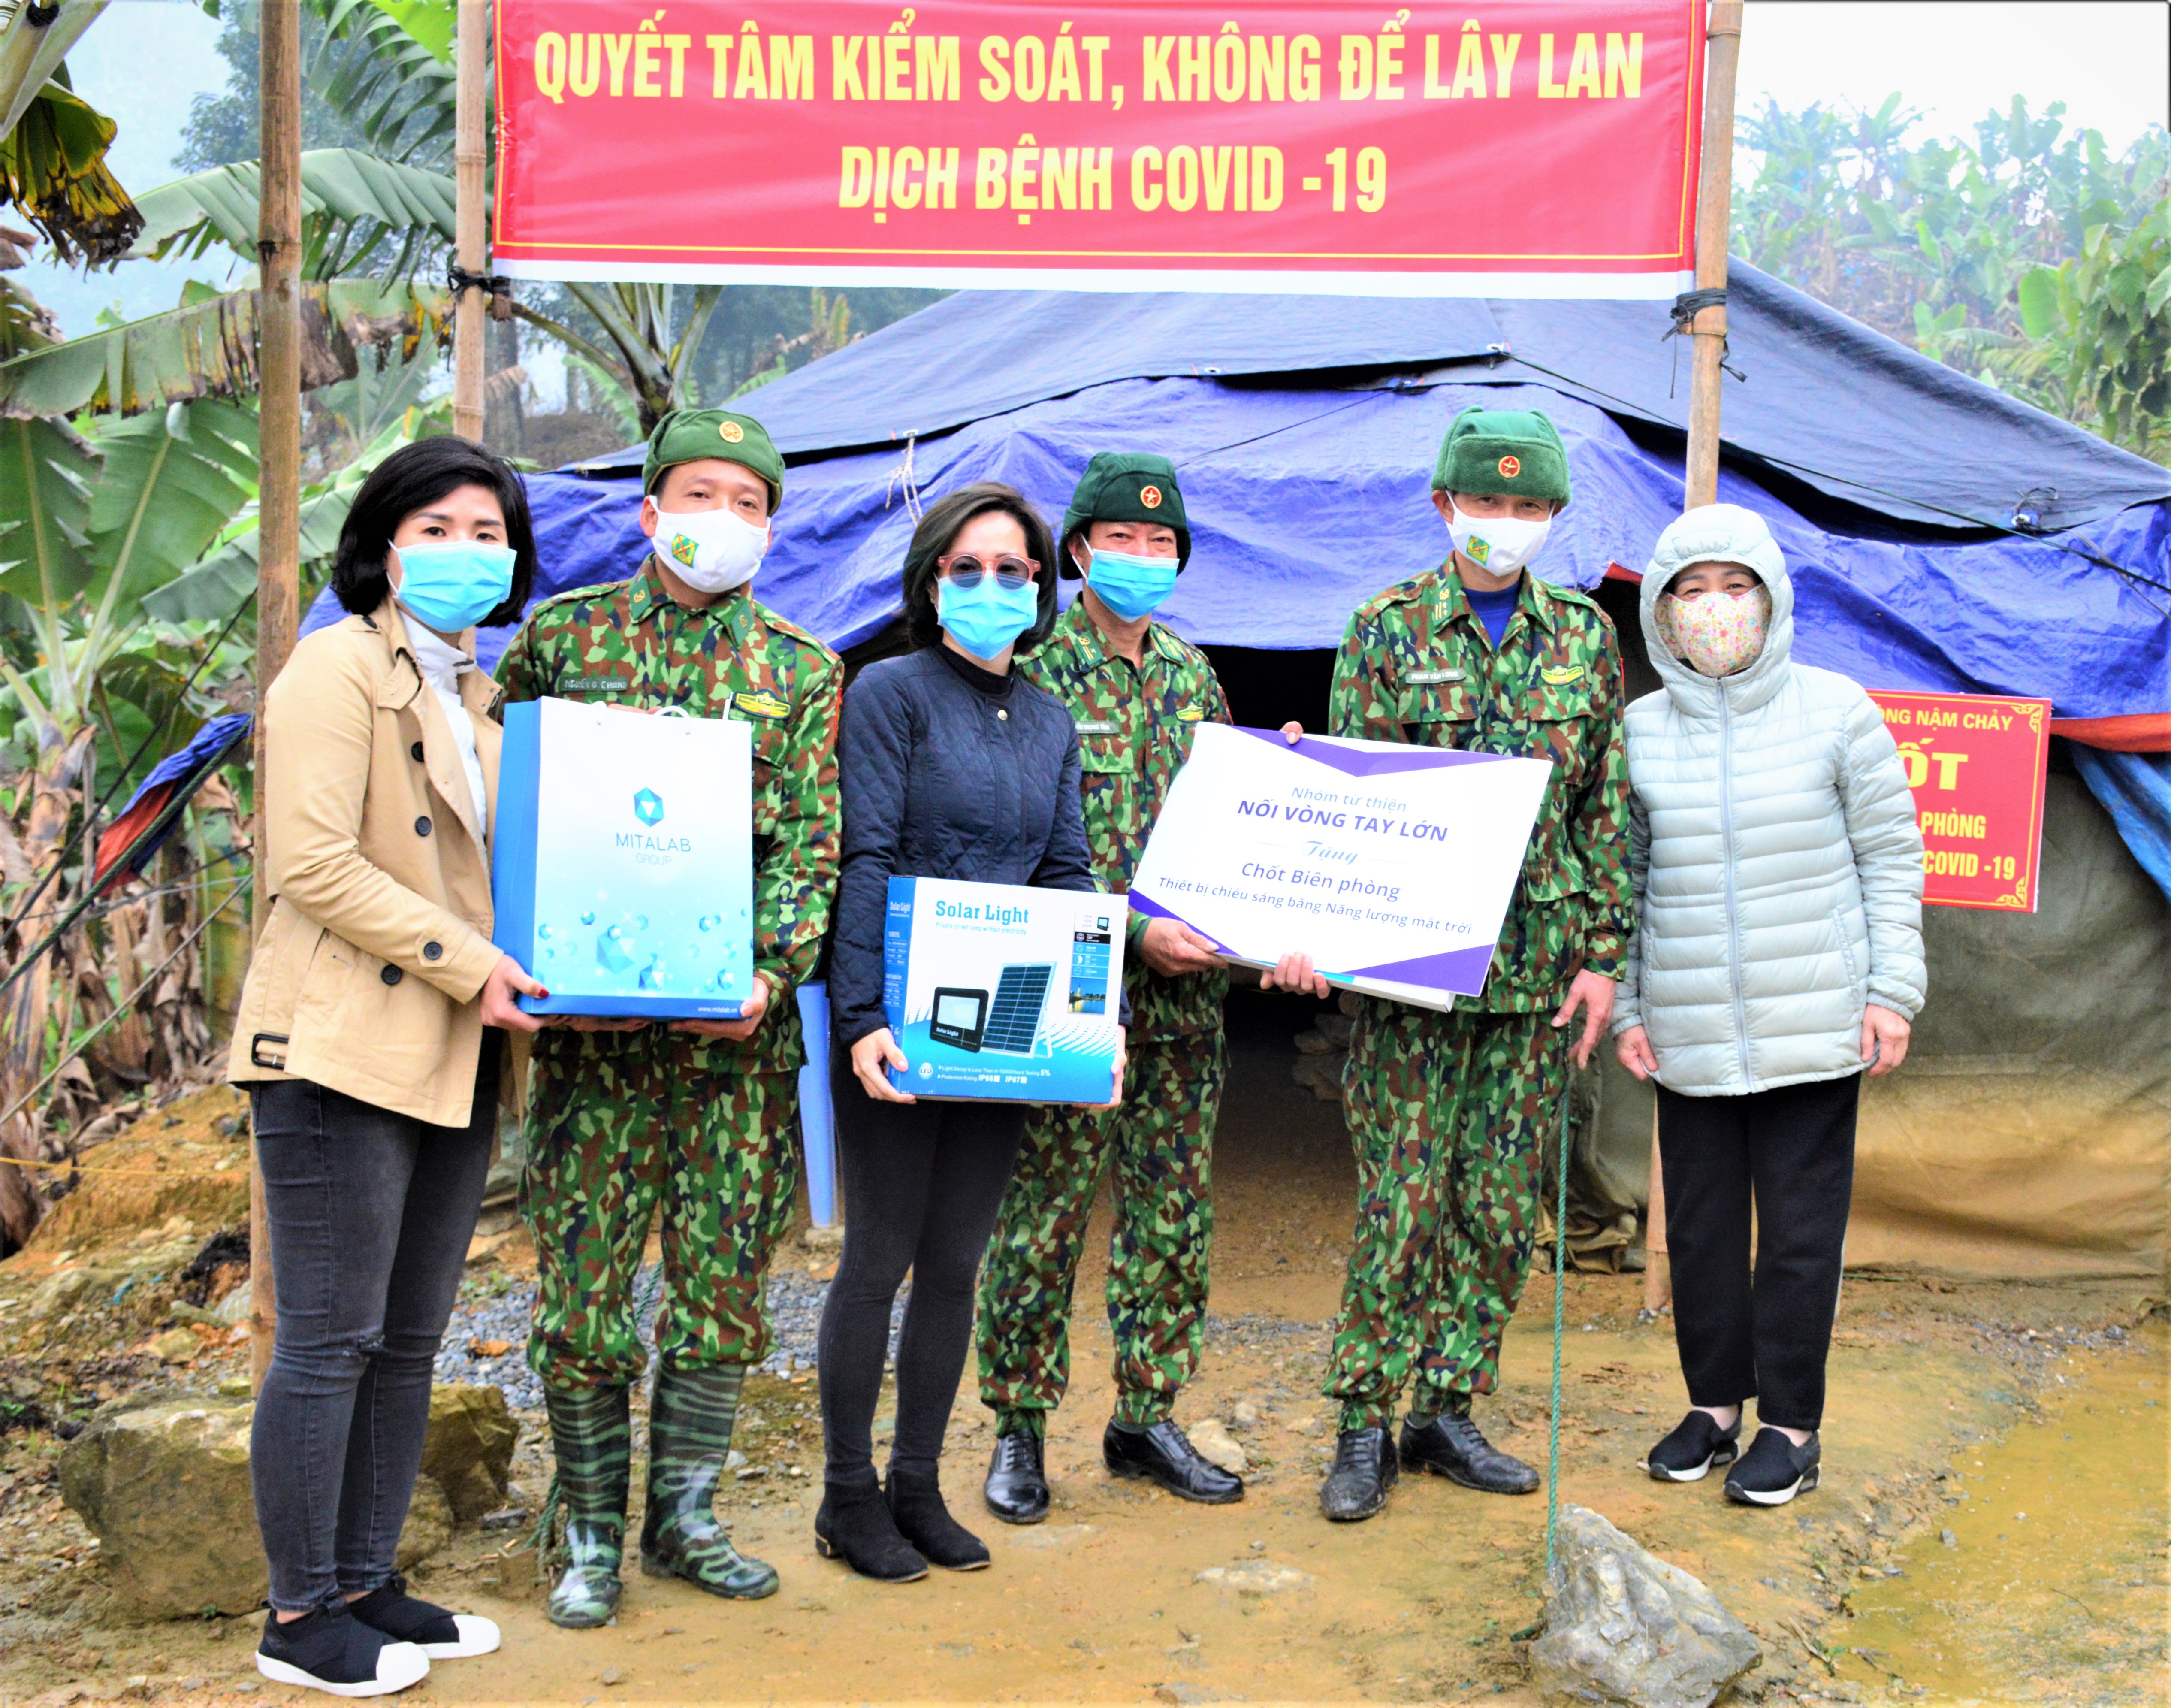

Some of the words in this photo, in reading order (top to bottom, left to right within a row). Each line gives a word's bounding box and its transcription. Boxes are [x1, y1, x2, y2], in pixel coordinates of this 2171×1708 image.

[534, 10, 691, 104] QUYẾT
[706, 20, 815, 100] TÂM
[832, 8, 960, 101] KIỂM
[978, 21, 1124, 110] SOÁT,
[1142, 21, 1321, 103] KHÔNG
[1338, 9, 1410, 100] ĐỂ
[1423, 19, 1522, 99] LÂY
[1537, 33, 1643, 99] LAN
[839, 146, 960, 223] DỊCH
[975, 133, 1112, 225] BỆNH
[1131, 145, 1284, 212] COVID
[1302, 146, 1387, 213] -19
[1916, 707, 1957, 731] NẬM
[1963, 709, 2013, 731] CHẢY
[1292, 787, 1338, 803] Nhóm
[1343, 794, 1362, 806] từ
[1366, 797, 1407, 813] thiện
[1237, 799, 1279, 819] NỐI
[1285, 804, 1347, 828] VÒNG
[1354, 816, 1395, 834] TAY
[1399, 820, 1448, 842] LỚN
[1920, 808, 1987, 839] PHÒNG
[616, 832, 691, 852] MITALAB
[1302, 840, 1359, 865] Tặng
[636, 853, 672, 865] GROUP
[1923, 850, 1978, 877] COVID
[1984, 856, 2015, 880] -19
[1242, 863, 1286, 881] Chốt
[1291, 870, 1332, 888] Biên
[1337, 878, 1401, 902] phòng
[936, 901, 980, 919] Solar
[985, 904, 1028, 925] Light
[1159, 877, 1193, 892] Thiết
[1196, 883, 1209, 896] bị
[1211, 886, 1248, 899] chiếu
[1251, 892, 1284, 908] sáng
[1288, 896, 1322, 914] bằng
[1326, 903, 1362, 920] Năng
[1366, 909, 1408, 927] lượng
[1412, 918, 1440, 931] mặt
[1445, 922, 1472, 934] trời
[1002, 928, 1026, 936] electricity
